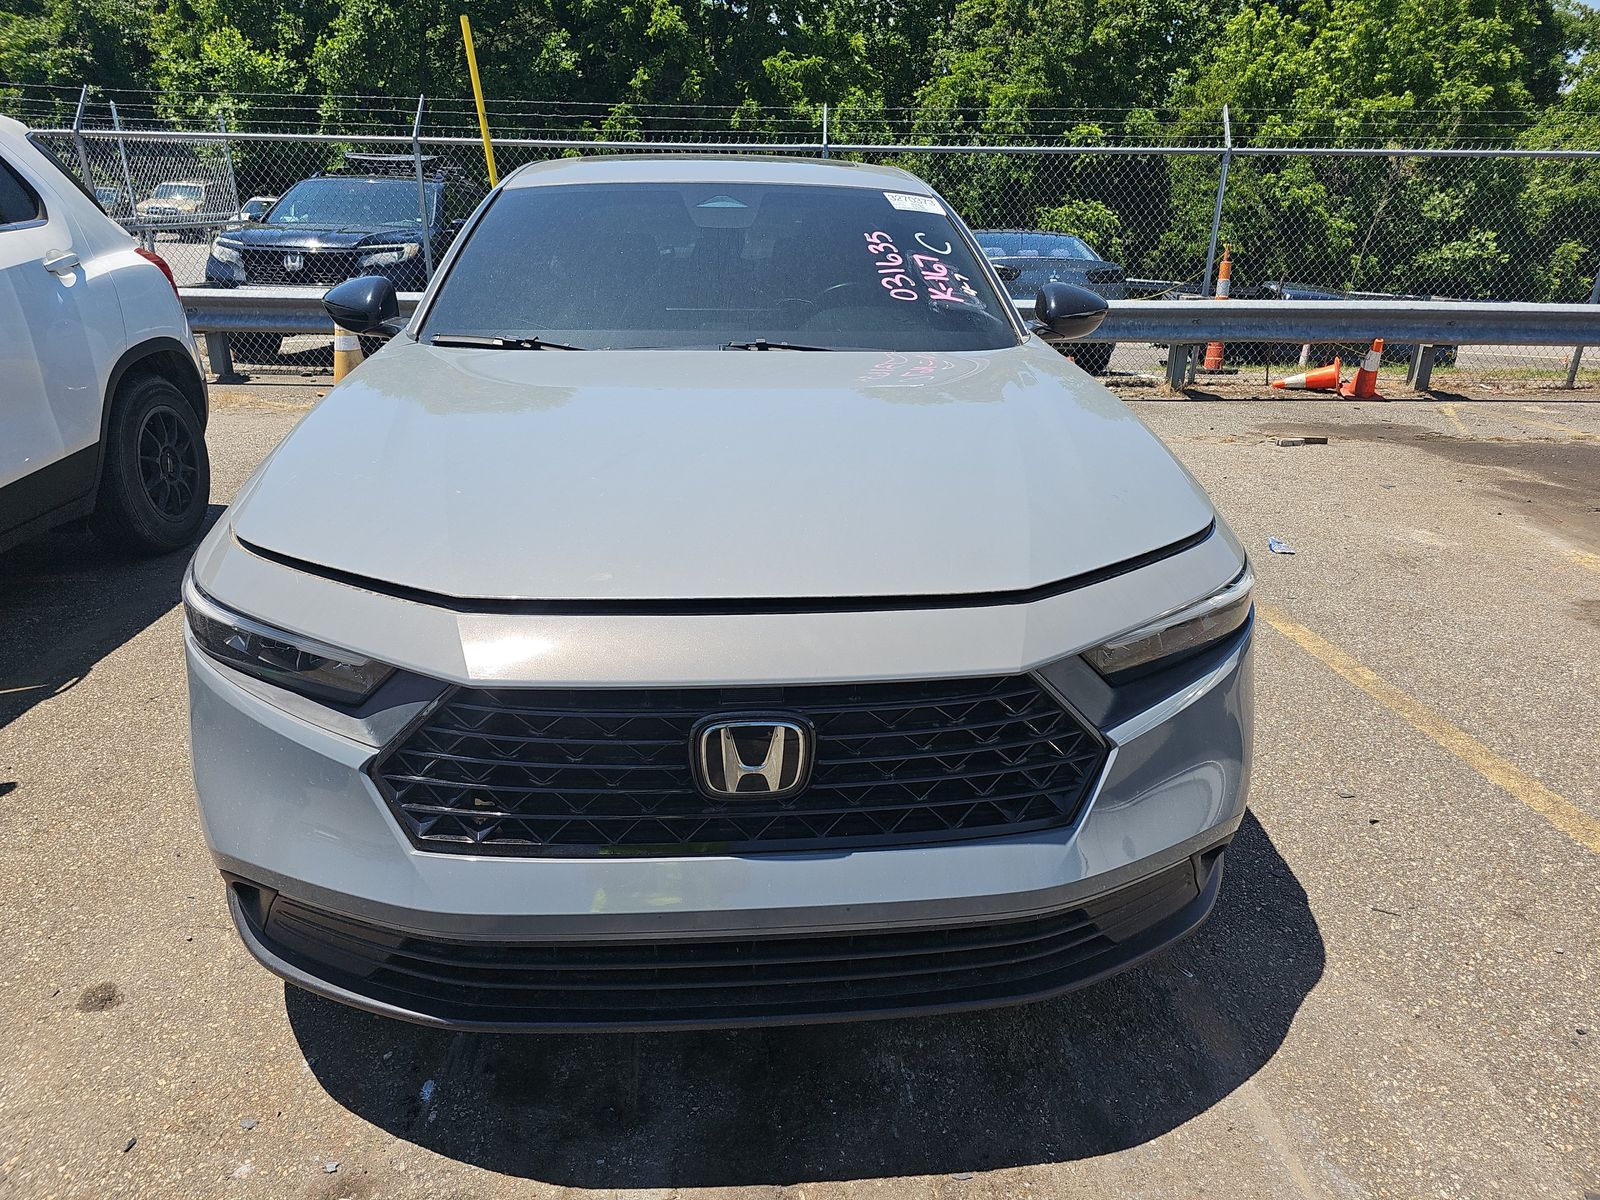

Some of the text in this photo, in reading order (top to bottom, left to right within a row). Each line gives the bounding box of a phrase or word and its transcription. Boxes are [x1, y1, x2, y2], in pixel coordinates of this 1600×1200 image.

[887, 194, 936, 206] 3270373
[863, 230, 919, 301] 031635
[912, 253, 964, 303] K-167
